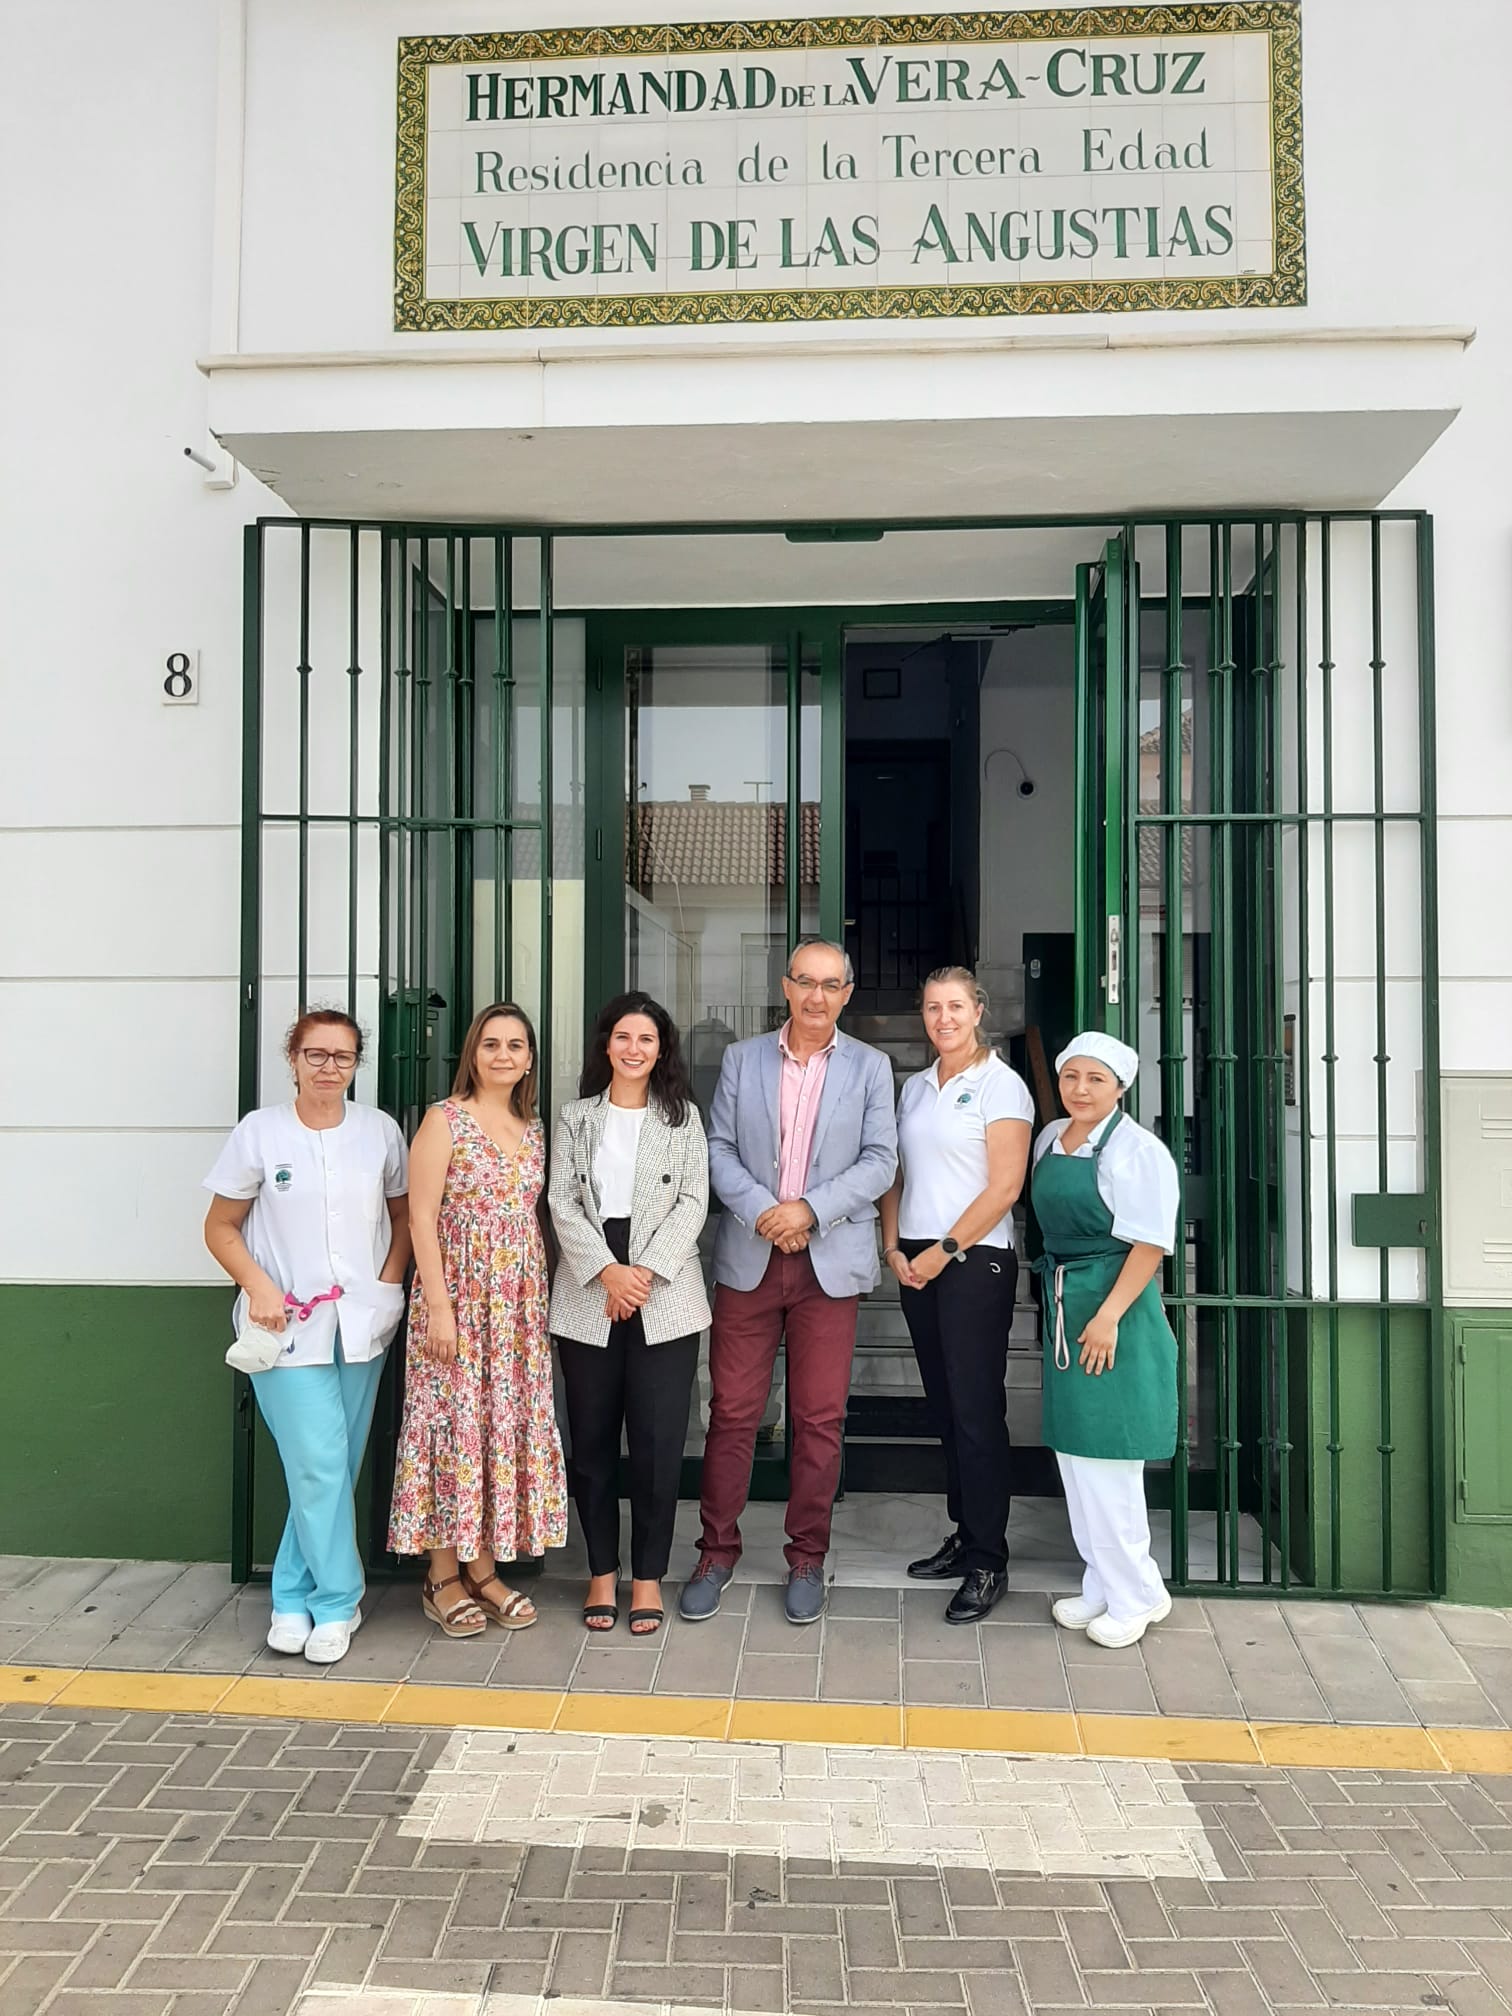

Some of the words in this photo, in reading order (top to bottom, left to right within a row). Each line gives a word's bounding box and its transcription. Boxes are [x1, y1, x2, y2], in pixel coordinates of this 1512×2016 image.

[465, 67, 776, 121] HERMANDAD
[781, 86, 816, 107] DE
[824, 83, 860, 106] LA
[475, 150, 704, 193] Residencia
[738, 142, 789, 182] de
[823, 140, 858, 181] la
[883, 134, 1043, 178] Tercera
[1083, 127, 1213, 171] Edad
[462, 222, 658, 281] VIRGEN
[690, 219, 758, 271] DE
[780, 215, 880, 268] LAS
[912, 204, 1233, 263] ANGUSTIAS
[164, 652, 192, 697] 8
